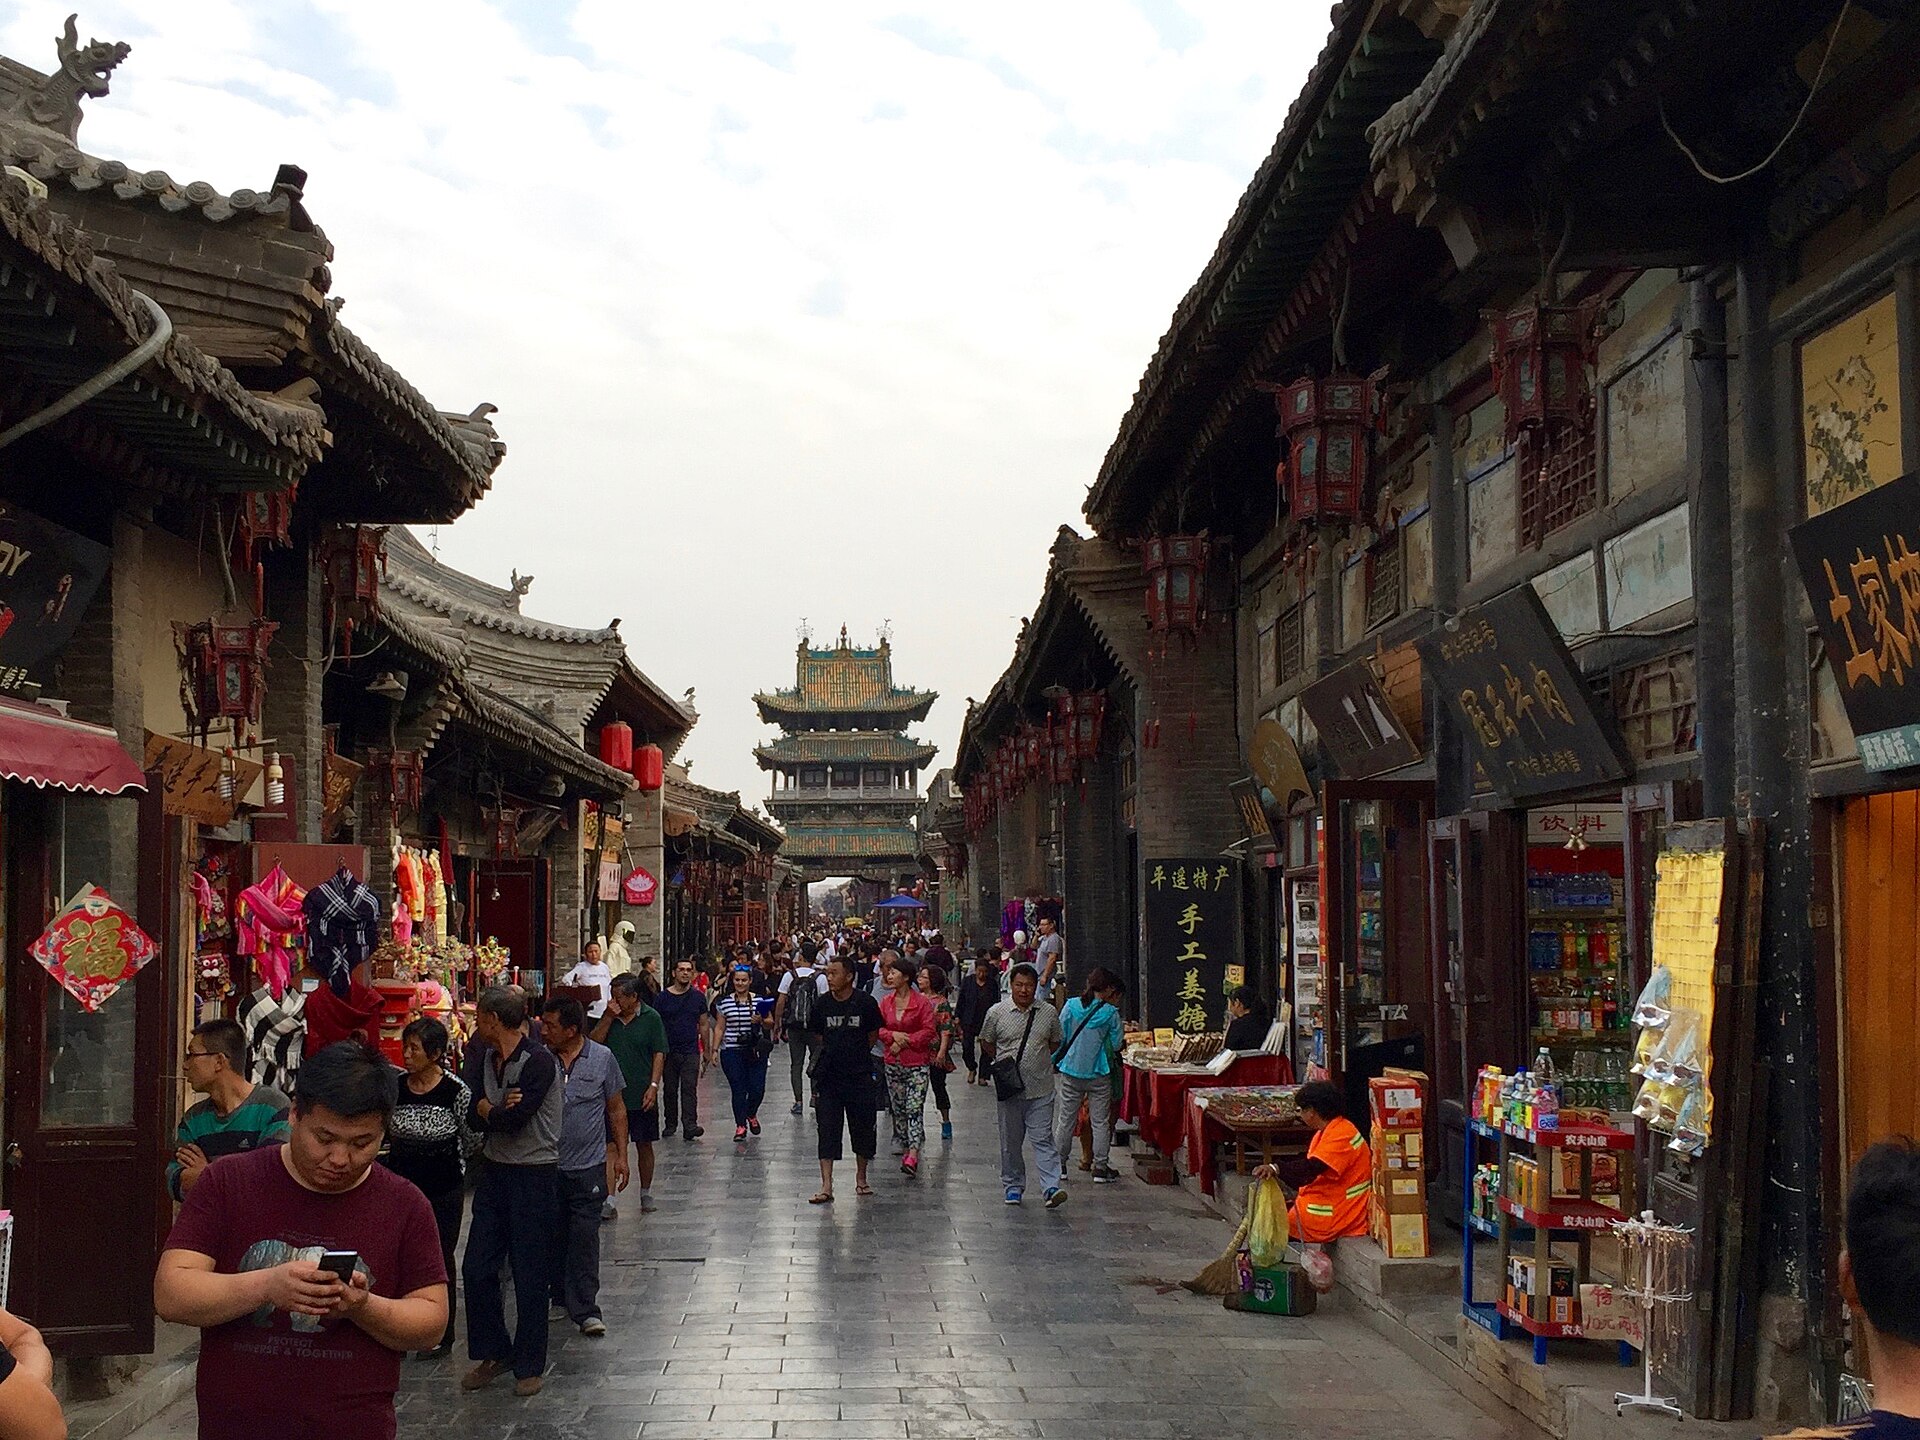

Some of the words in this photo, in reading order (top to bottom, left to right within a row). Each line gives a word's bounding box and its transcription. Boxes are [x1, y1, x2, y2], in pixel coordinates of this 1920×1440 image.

[1459, 653, 1576, 749] 冠云牛肉
[1540, 815, 1606, 832] 饮料
[1150, 865, 1230, 891] 平遥特产
[62, 915, 128, 980] 福
[1174, 902, 1208, 1031] 手工姜糖
[1565, 1134, 1608, 1147] 农夫山泉
[1563, 1215, 1605, 1228] 农夫山泉
